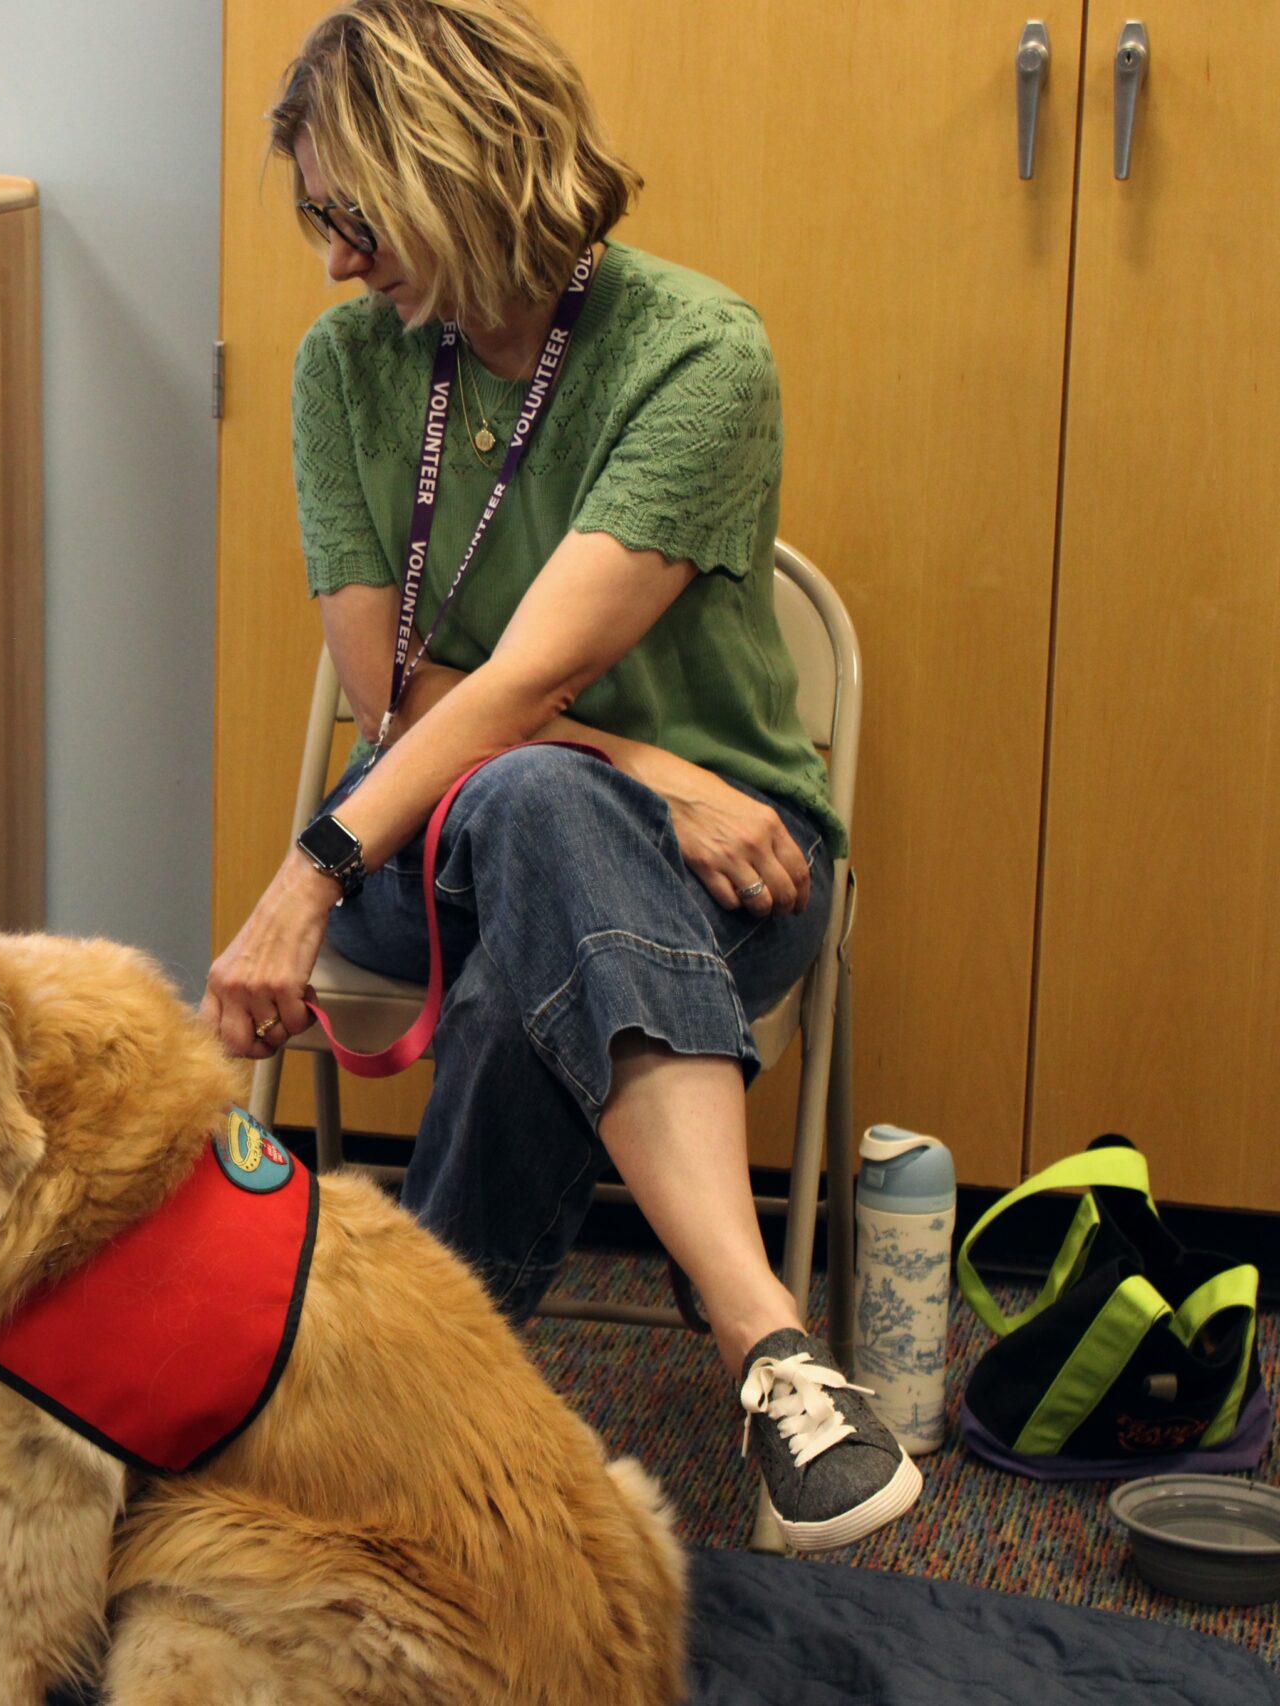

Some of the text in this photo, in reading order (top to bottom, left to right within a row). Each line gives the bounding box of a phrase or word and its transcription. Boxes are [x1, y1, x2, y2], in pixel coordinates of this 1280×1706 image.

[441, 321, 456, 347] ER
[511, 327, 569, 448] VOLUNTEER
[417, 381, 450, 505] VOLUNTEER
[396, 541, 426, 665] VOLUNTEER
